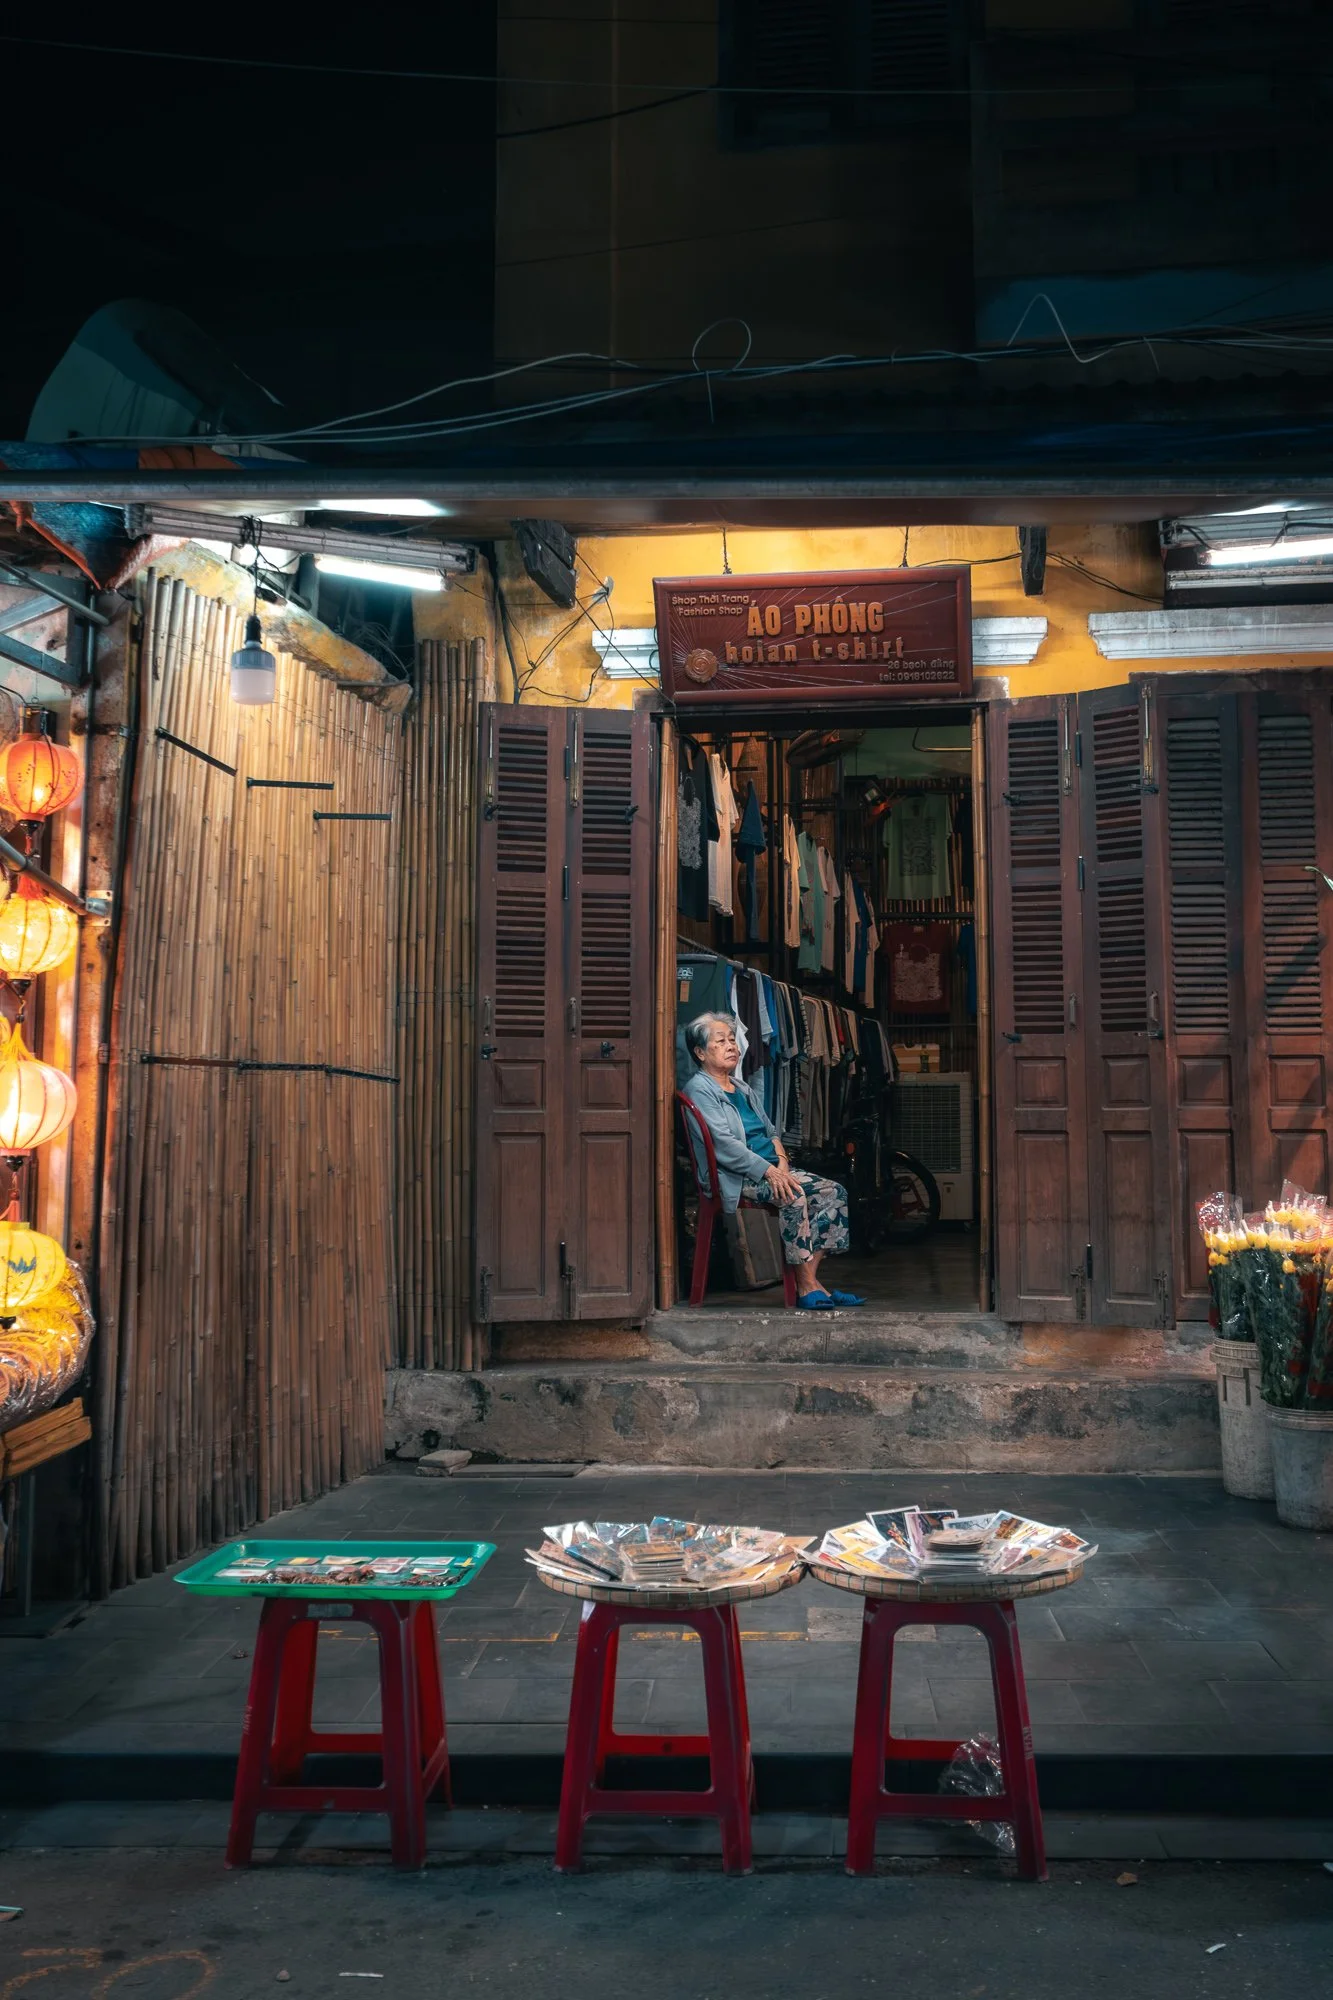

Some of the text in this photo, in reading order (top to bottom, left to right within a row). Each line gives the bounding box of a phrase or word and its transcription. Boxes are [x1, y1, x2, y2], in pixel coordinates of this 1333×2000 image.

[672, 595, 697, 605] Shop
[721, 594, 749, 604] Trang
[679, 606, 743, 616] Fashion Shop
[747, 596, 884, 636] ÁO PHÔNG
[812, 636, 903, 661] t-shirt
